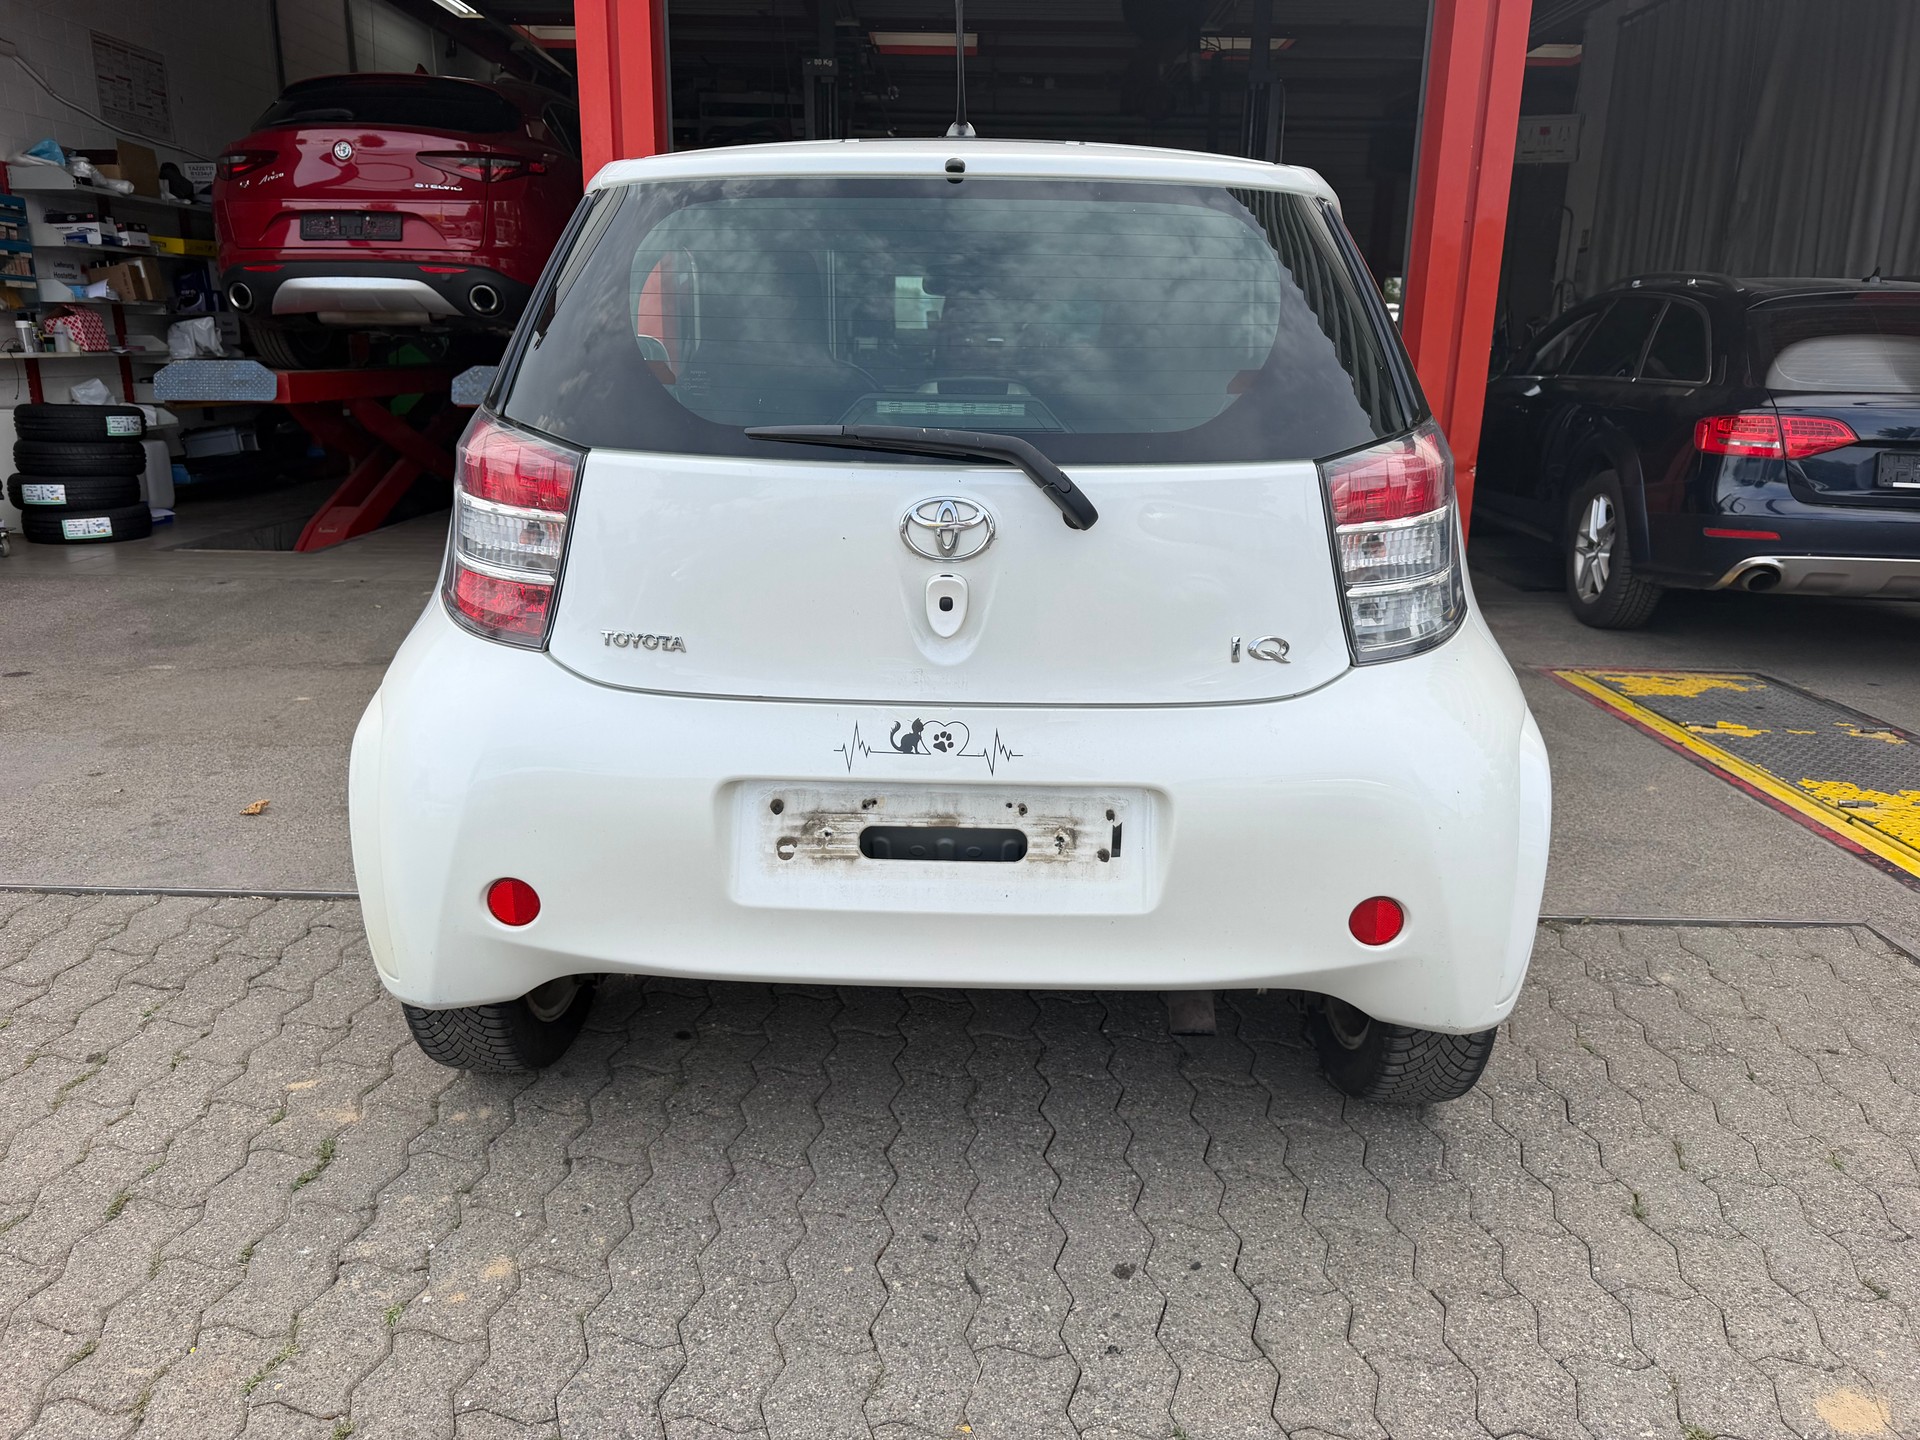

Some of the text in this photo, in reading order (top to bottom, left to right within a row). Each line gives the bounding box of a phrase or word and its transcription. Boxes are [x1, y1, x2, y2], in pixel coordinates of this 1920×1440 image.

[414, 182, 464, 192] STELVIO
[54, 261, 75, 270] Lieferung
[600, 629, 687, 653] TOYOTA
